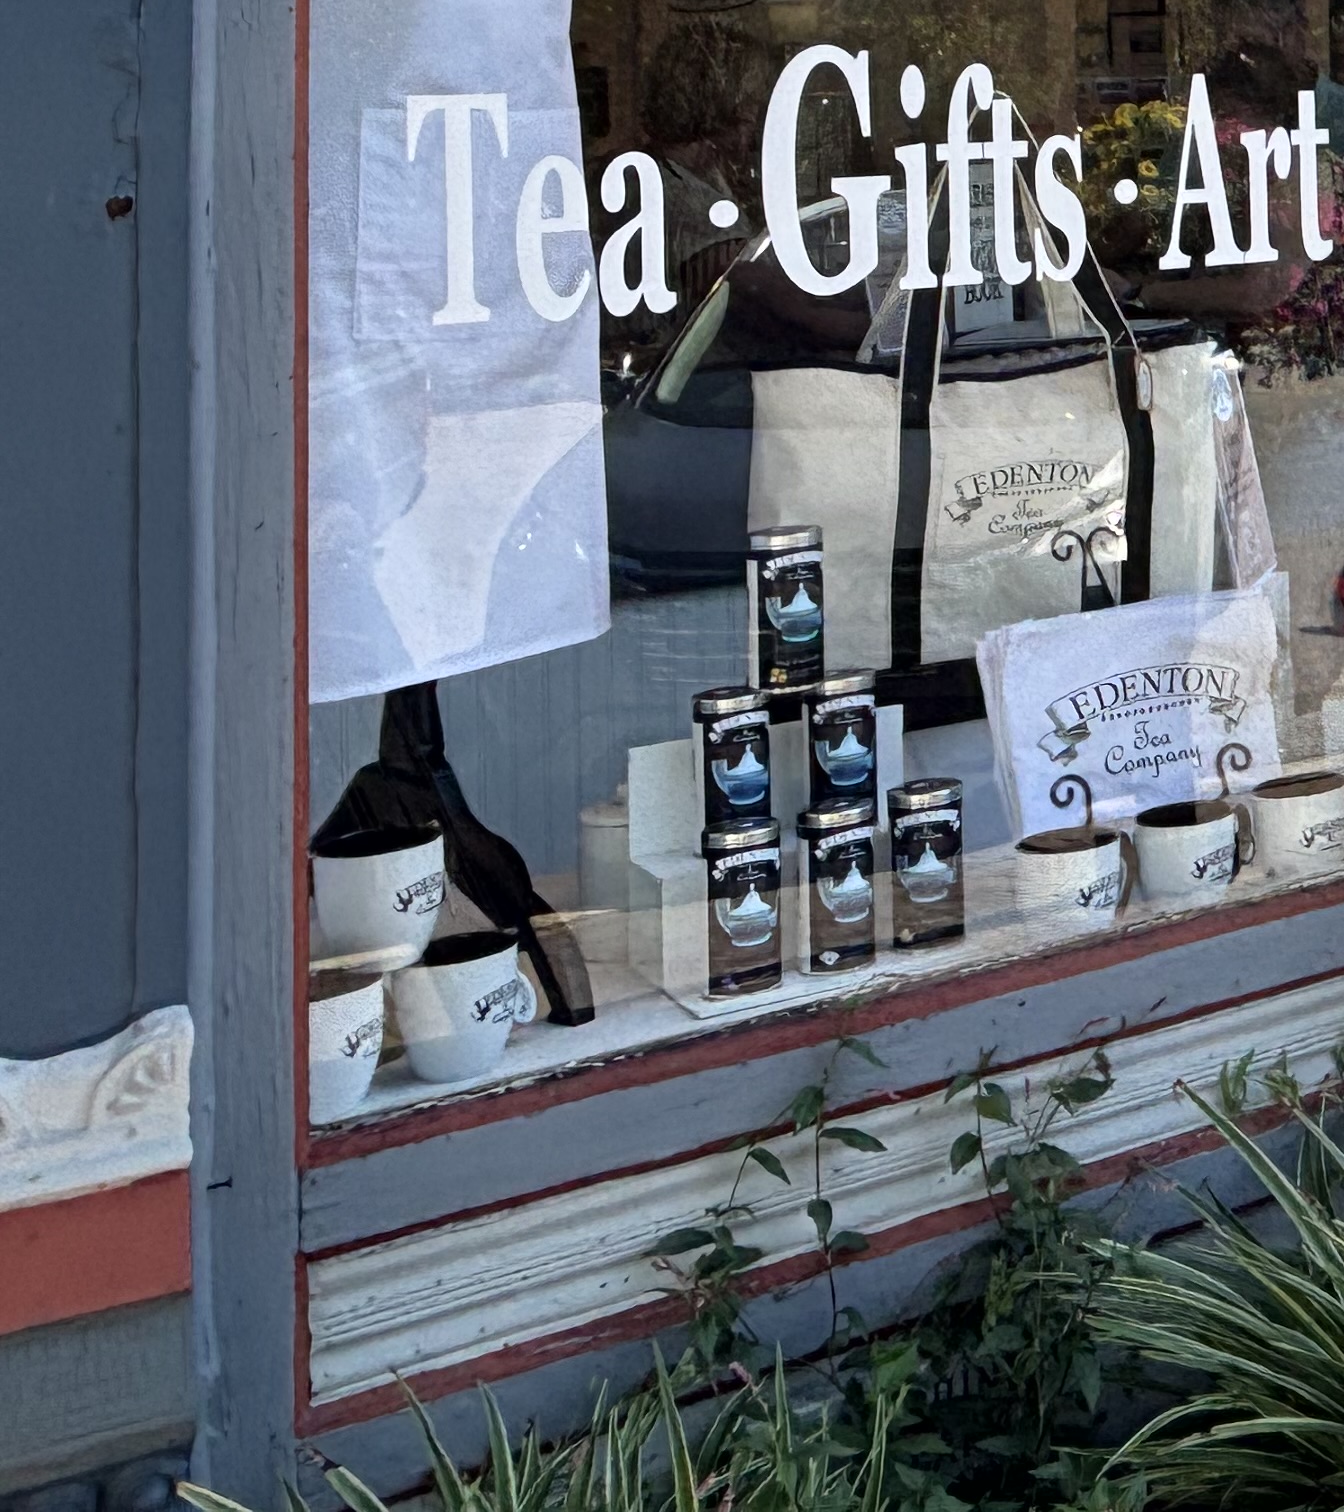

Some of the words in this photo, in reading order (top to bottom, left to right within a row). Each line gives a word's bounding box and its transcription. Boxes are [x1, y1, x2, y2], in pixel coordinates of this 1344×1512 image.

[406, 93, 678, 327] Tea
[761, 43, 1088, 297] Gifts
[1158, 72, 1334, 271] Art
[1069, 667, 1227, 720] EDENTON
[1133, 720, 1172, 750] Tea
[1104, 744, 1203, 778] Company
